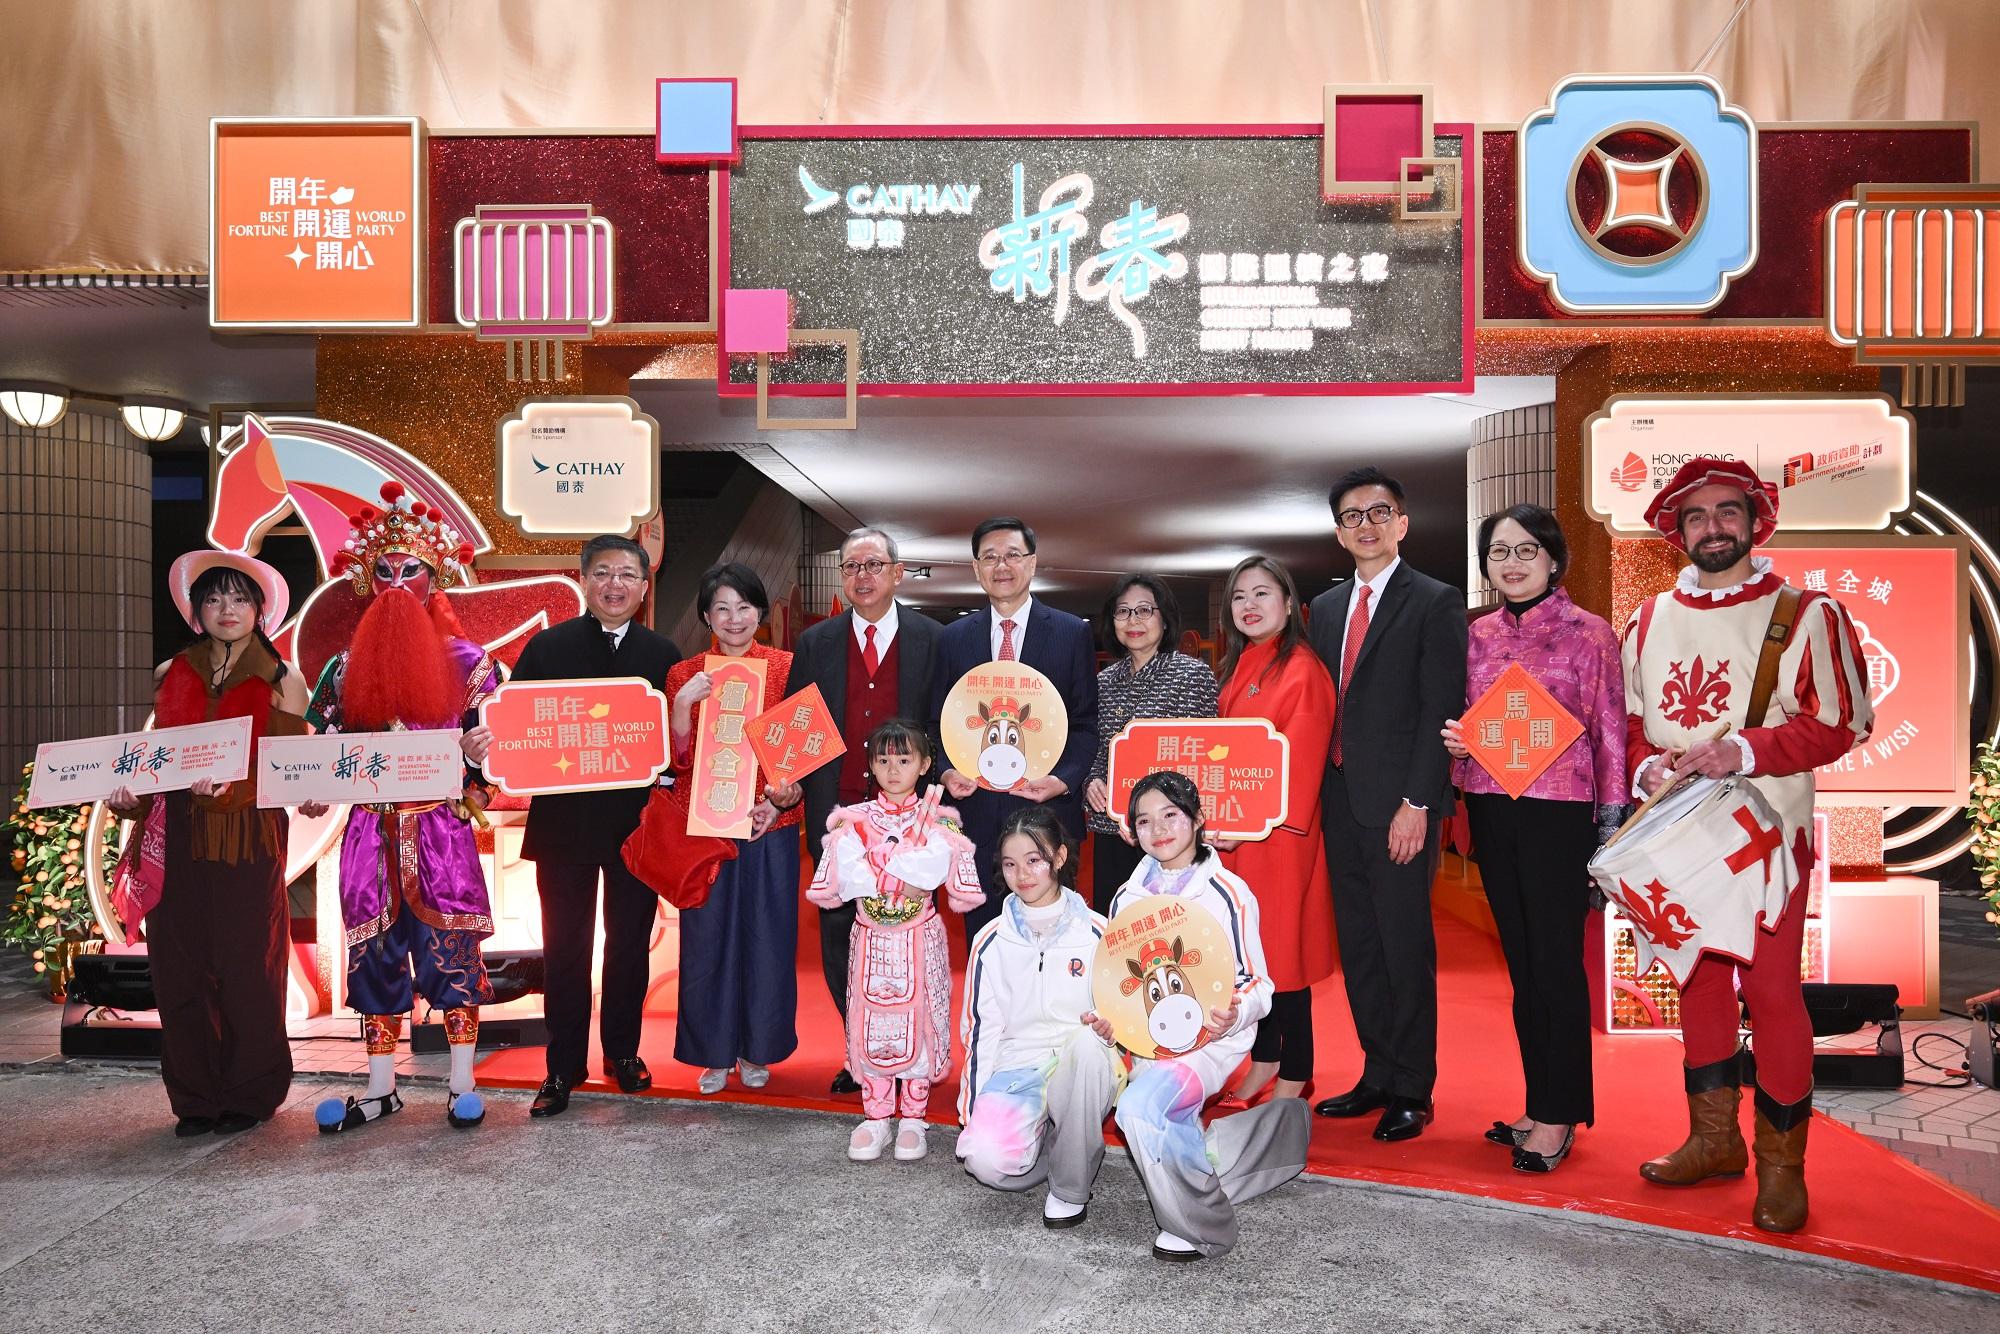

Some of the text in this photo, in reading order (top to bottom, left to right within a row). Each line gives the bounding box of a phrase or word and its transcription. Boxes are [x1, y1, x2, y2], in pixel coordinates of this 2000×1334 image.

[269, 177, 327, 206] 開年
[846, 184, 980, 214] CATHAY
[260, 211, 290, 223] BEST
[293, 209, 352, 239] 開運
[356, 211, 406, 223] WORLD
[229, 225, 288, 237] FORTUNE
[356, 225, 396, 237] PARTY
[980, 162, 1188, 328] 新春
[316, 241, 375, 270] 開心
[1652, 453, 1692, 464] HONG
[1817, 444, 1860, 467] 政府資助
[556, 462, 625, 475] CATHAY
[1653, 467, 1679, 476] TOUR
[1797, 459, 1860, 483] Government-funded
[1830, 465, 1865, 481] programme
[556, 480, 585, 493] 國泰
[1784, 568, 1893, 605] 運全城
[967, 676, 1043, 690] 開年 開運 開心
[533, 696, 587, 722] 開年
[527, 727, 554, 738] BEST
[557, 722, 610, 748] 開運
[612, 721, 655, 732] WORLD
[498, 739, 553, 750] FORTUNE
[613, 734, 649, 744] PARTY
[708, 681, 748, 812] 福運全城
[1862, 749, 1874, 768] A
[1875, 720, 1919, 760] WISH
[1156, 736, 1206, 762] 開年
[61, 762, 103, 773] CATHAY
[112, 742, 175, 779] 新春
[284, 763, 322, 772] CATHAY
[332, 743, 390, 787] 新春
[579, 749, 631, 775] 開心
[1229, 767, 1274, 779] WORLD
[1229, 779, 1266, 791] PARTY
[1199, 795, 1245, 822] 開心
[1105, 902, 1186, 948] 開年 開運 開心
